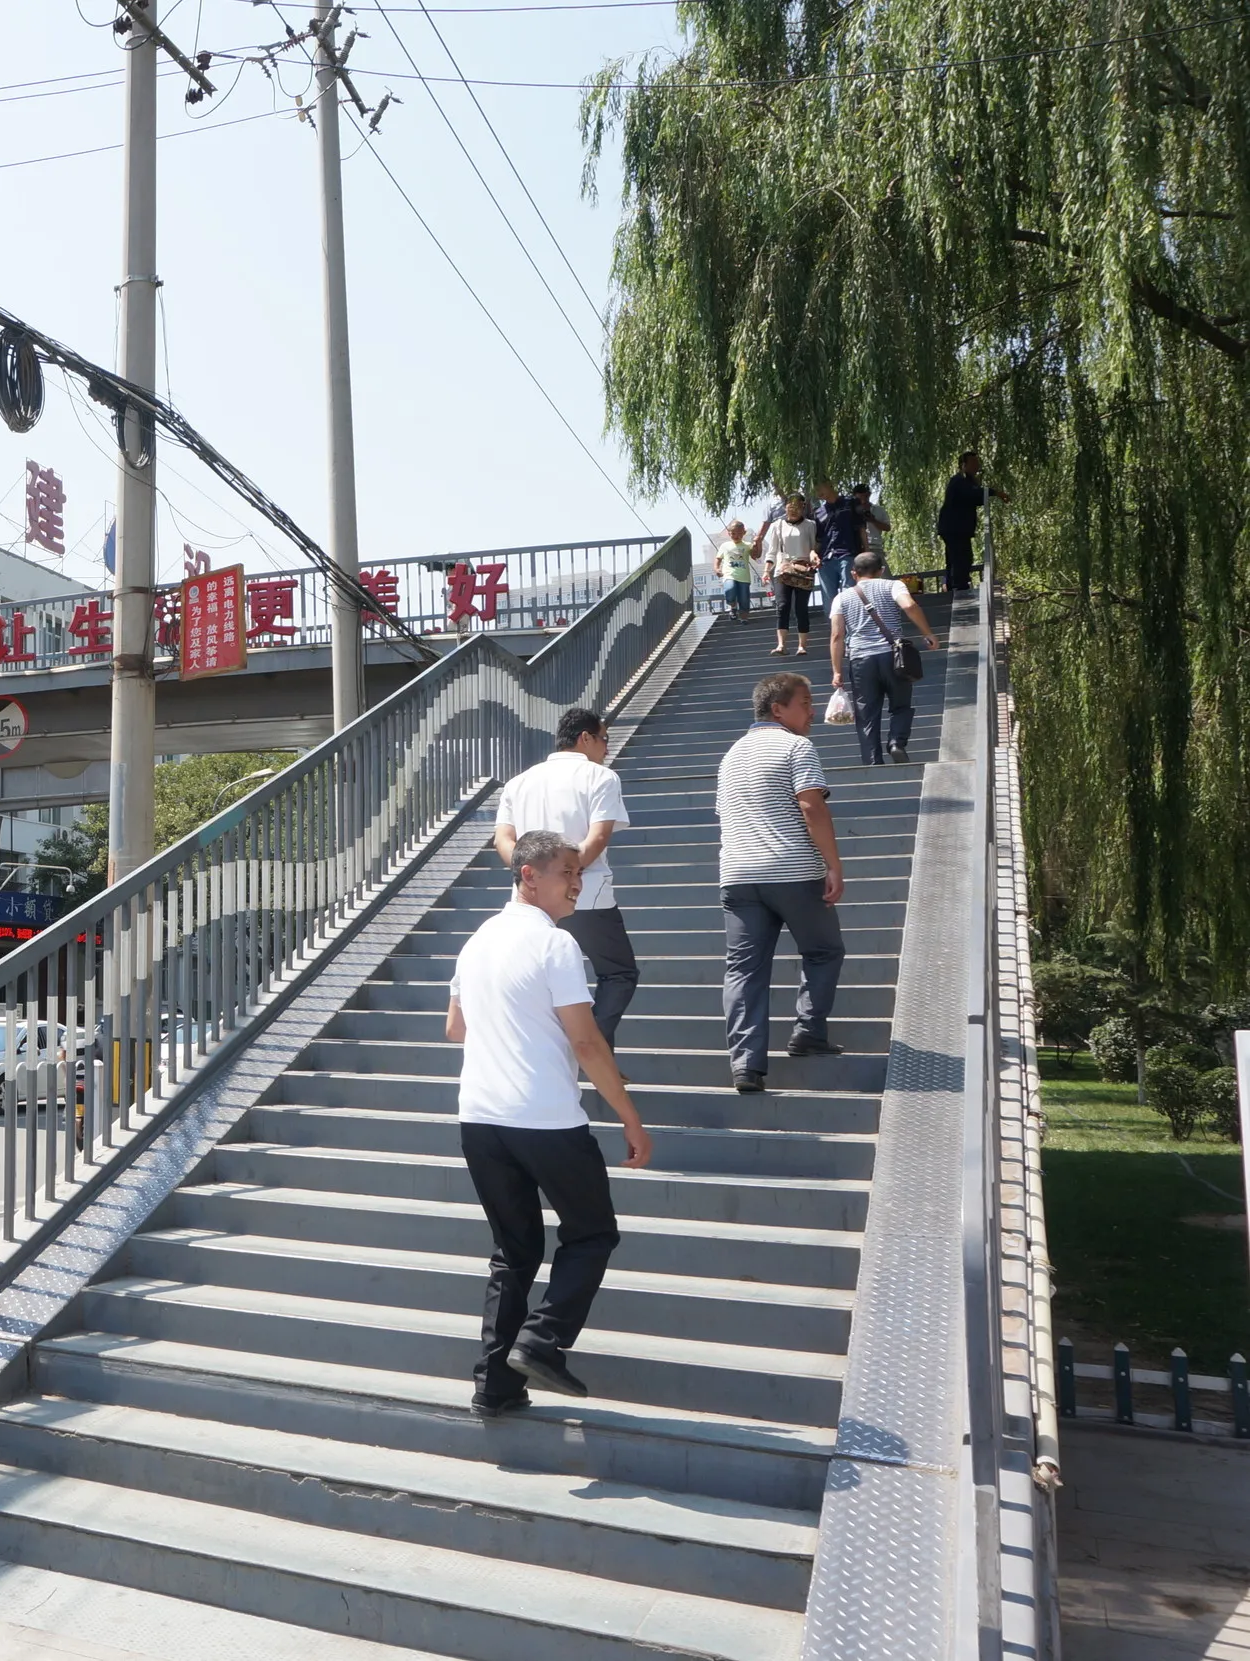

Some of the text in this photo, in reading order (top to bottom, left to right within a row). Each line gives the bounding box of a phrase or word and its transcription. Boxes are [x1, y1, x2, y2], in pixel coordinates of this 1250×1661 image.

[189, 605, 202, 670] 为了您及家人
